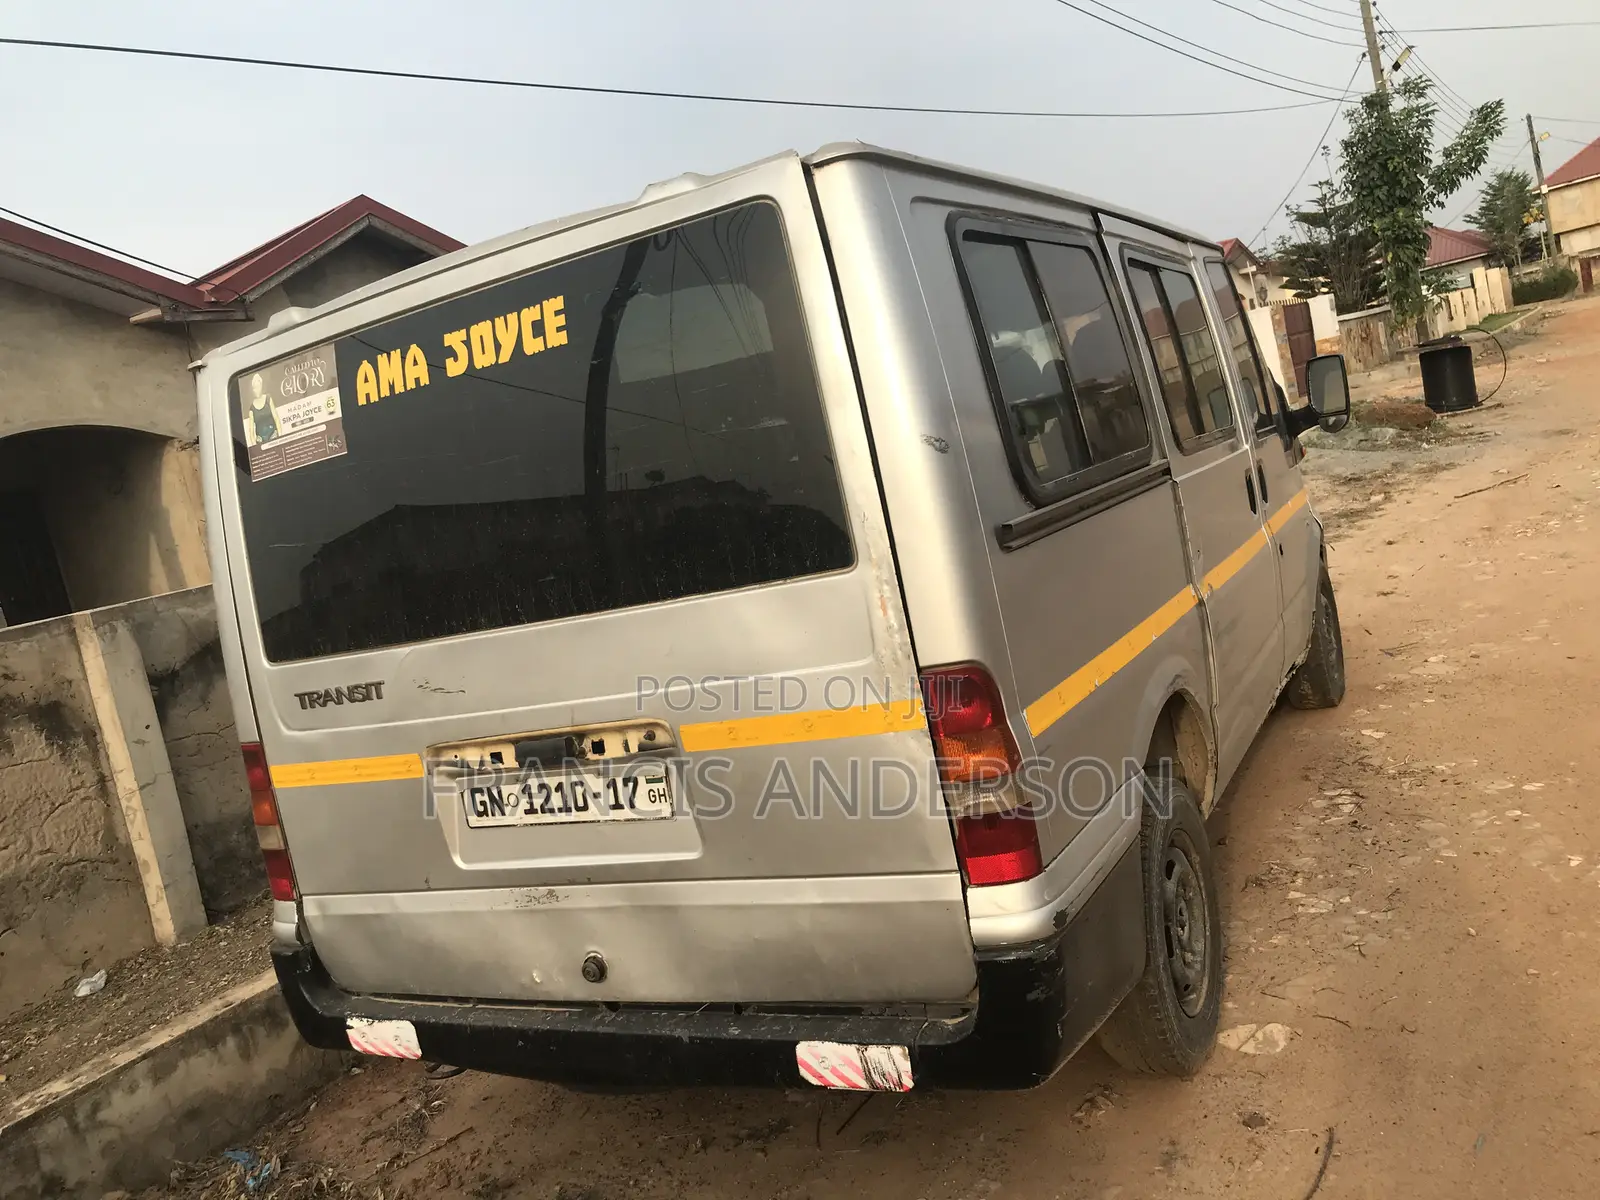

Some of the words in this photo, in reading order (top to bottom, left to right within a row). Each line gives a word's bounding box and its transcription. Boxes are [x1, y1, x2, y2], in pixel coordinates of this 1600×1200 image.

[356, 343, 430, 406] AMA
[443, 295, 568, 378] JOYCE
[280, 366, 326, 397] GLORY
[282, 412, 301, 424] SIKPA
[302, 406, 322, 417] JOYCE
[287, 400, 312, 413] MADAM
[326, 398, 336, 408] 63
[294, 680, 385, 710] TRANSIT
[470, 786, 506, 817] GN
[647, 787, 667, 804] GH
